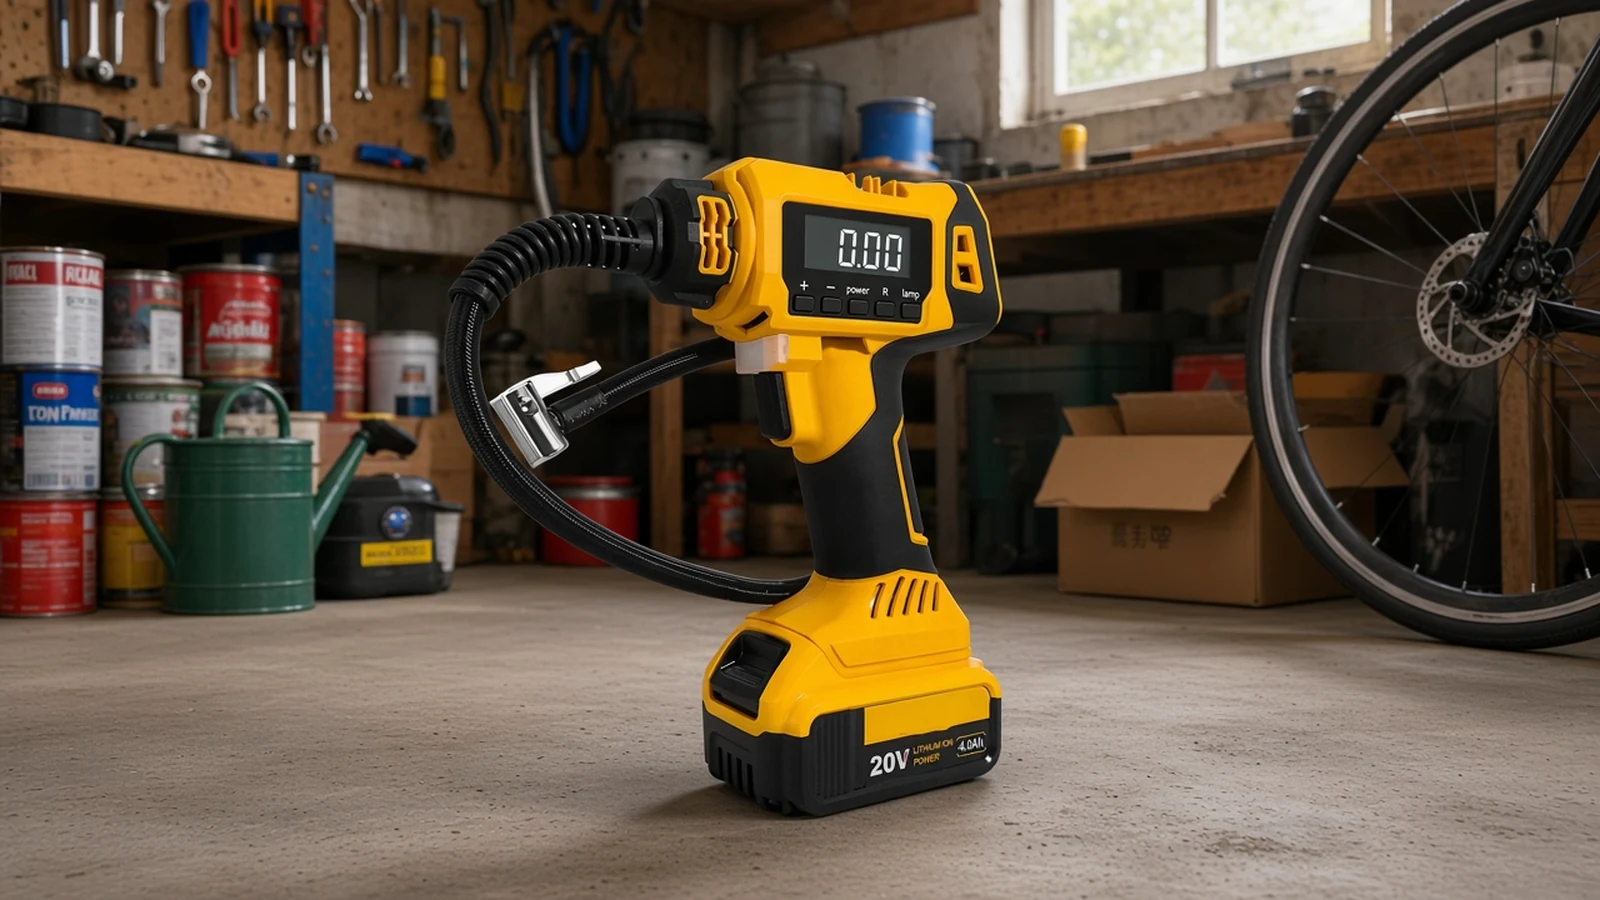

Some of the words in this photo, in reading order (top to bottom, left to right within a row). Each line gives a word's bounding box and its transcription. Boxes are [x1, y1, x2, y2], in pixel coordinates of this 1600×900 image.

[838, 228, 902, 272] 0.00
[846, 286, 870, 295] power
[882, 287, 889, 296] R
[902, 288, 920, 300] lamp
[869, 748, 911, 777] 20V
